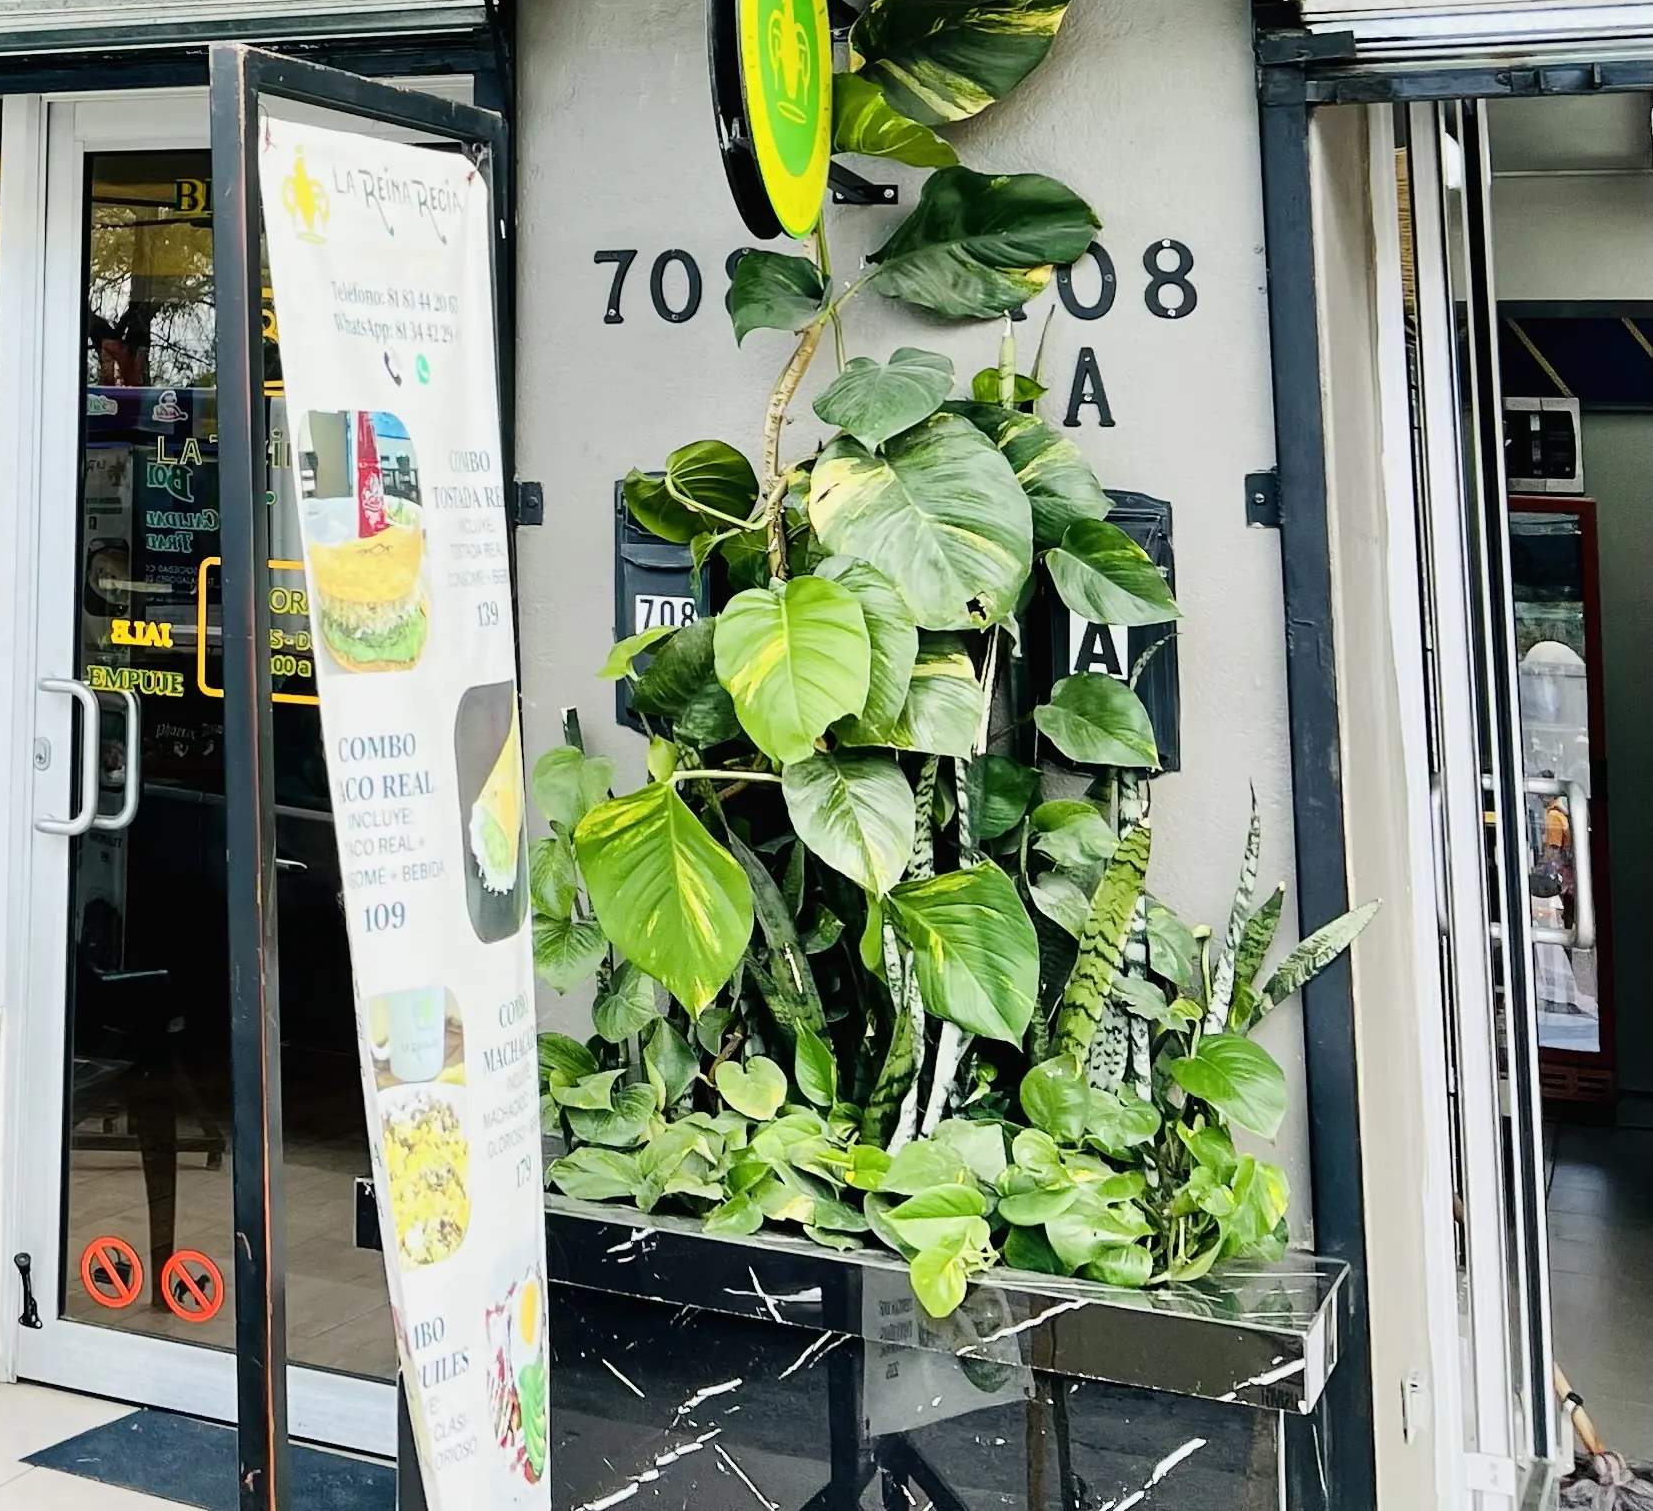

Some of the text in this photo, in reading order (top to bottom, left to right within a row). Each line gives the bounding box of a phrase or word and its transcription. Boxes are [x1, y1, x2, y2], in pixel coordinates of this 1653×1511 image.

[333, 166, 357, 196] LA
[594, 239, 1198, 325] 70 08
[1063, 347, 1115, 427] A
[157, 436, 202, 465] LA
[449, 450, 490, 473] COMBO
[478, 600, 500, 627] 139
[1075, 623, 1123, 677] A
[87, 665, 184, 698] EMPUJE
[338, 733, 416, 763] COMBO
[382, 769, 435, 800] REAL
[364, 900, 406, 933] 109
